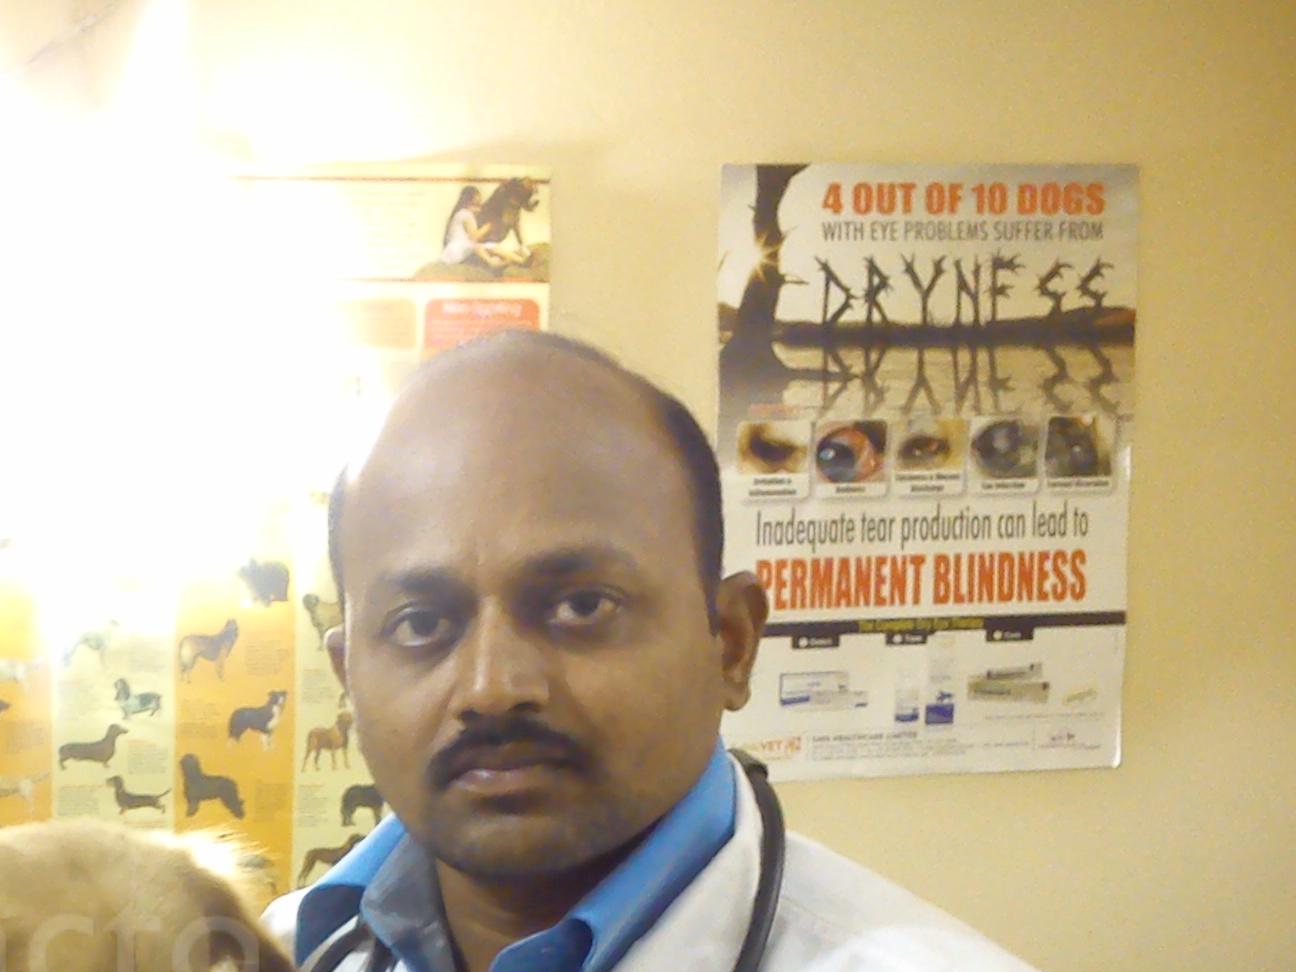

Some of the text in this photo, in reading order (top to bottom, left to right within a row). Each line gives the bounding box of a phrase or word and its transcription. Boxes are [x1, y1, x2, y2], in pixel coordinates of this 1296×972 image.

[822, 182, 1105, 214] 4 OUT OF 10 DOGS
[822, 220, 1103, 240] WITH EYE PROBLEMS SUFFER FROM
[814, 252, 1114, 326] DRYNESS
[757, 500, 1089, 553] Inadequate tear production can lead to
[756, 549, 1086, 610] PERMANENT BLINDNESS
